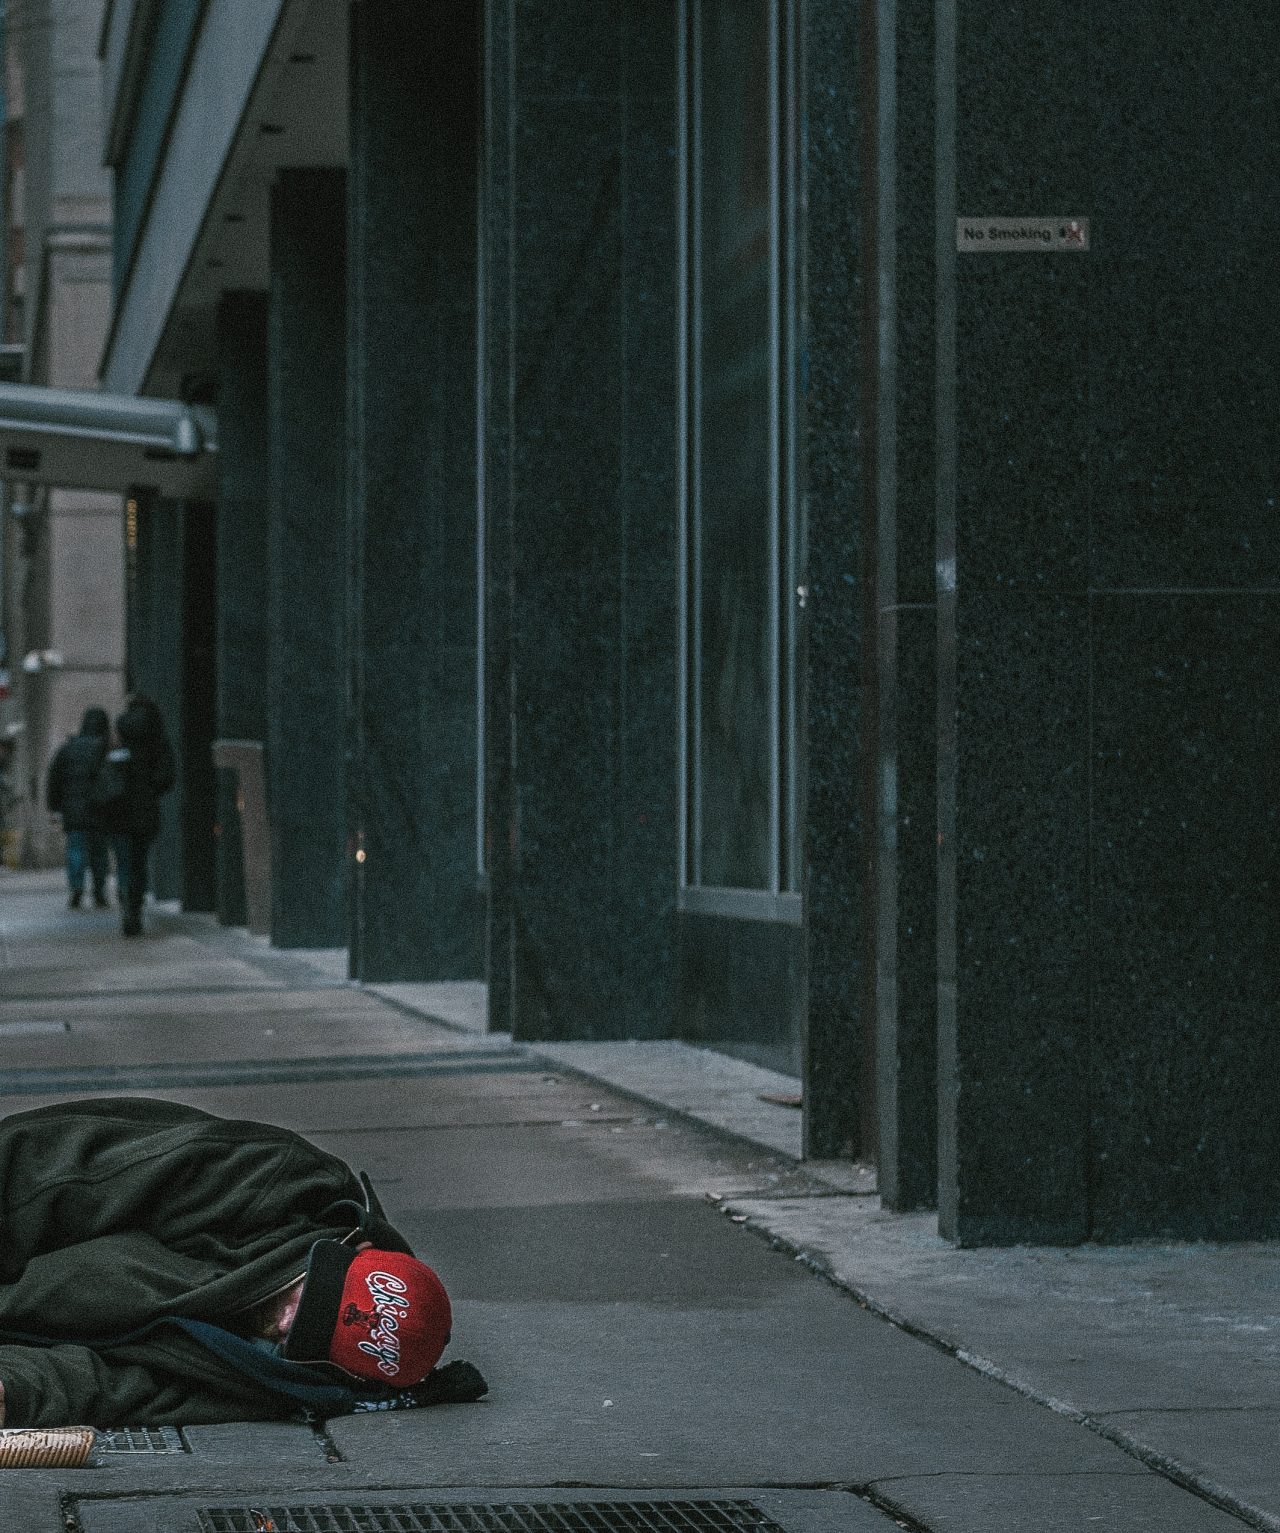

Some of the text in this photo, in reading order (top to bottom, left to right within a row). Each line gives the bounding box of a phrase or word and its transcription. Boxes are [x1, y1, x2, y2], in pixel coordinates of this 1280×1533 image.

[963, 227, 1052, 243] No Smoking
[358, 1272, 409, 1376] Chicago
